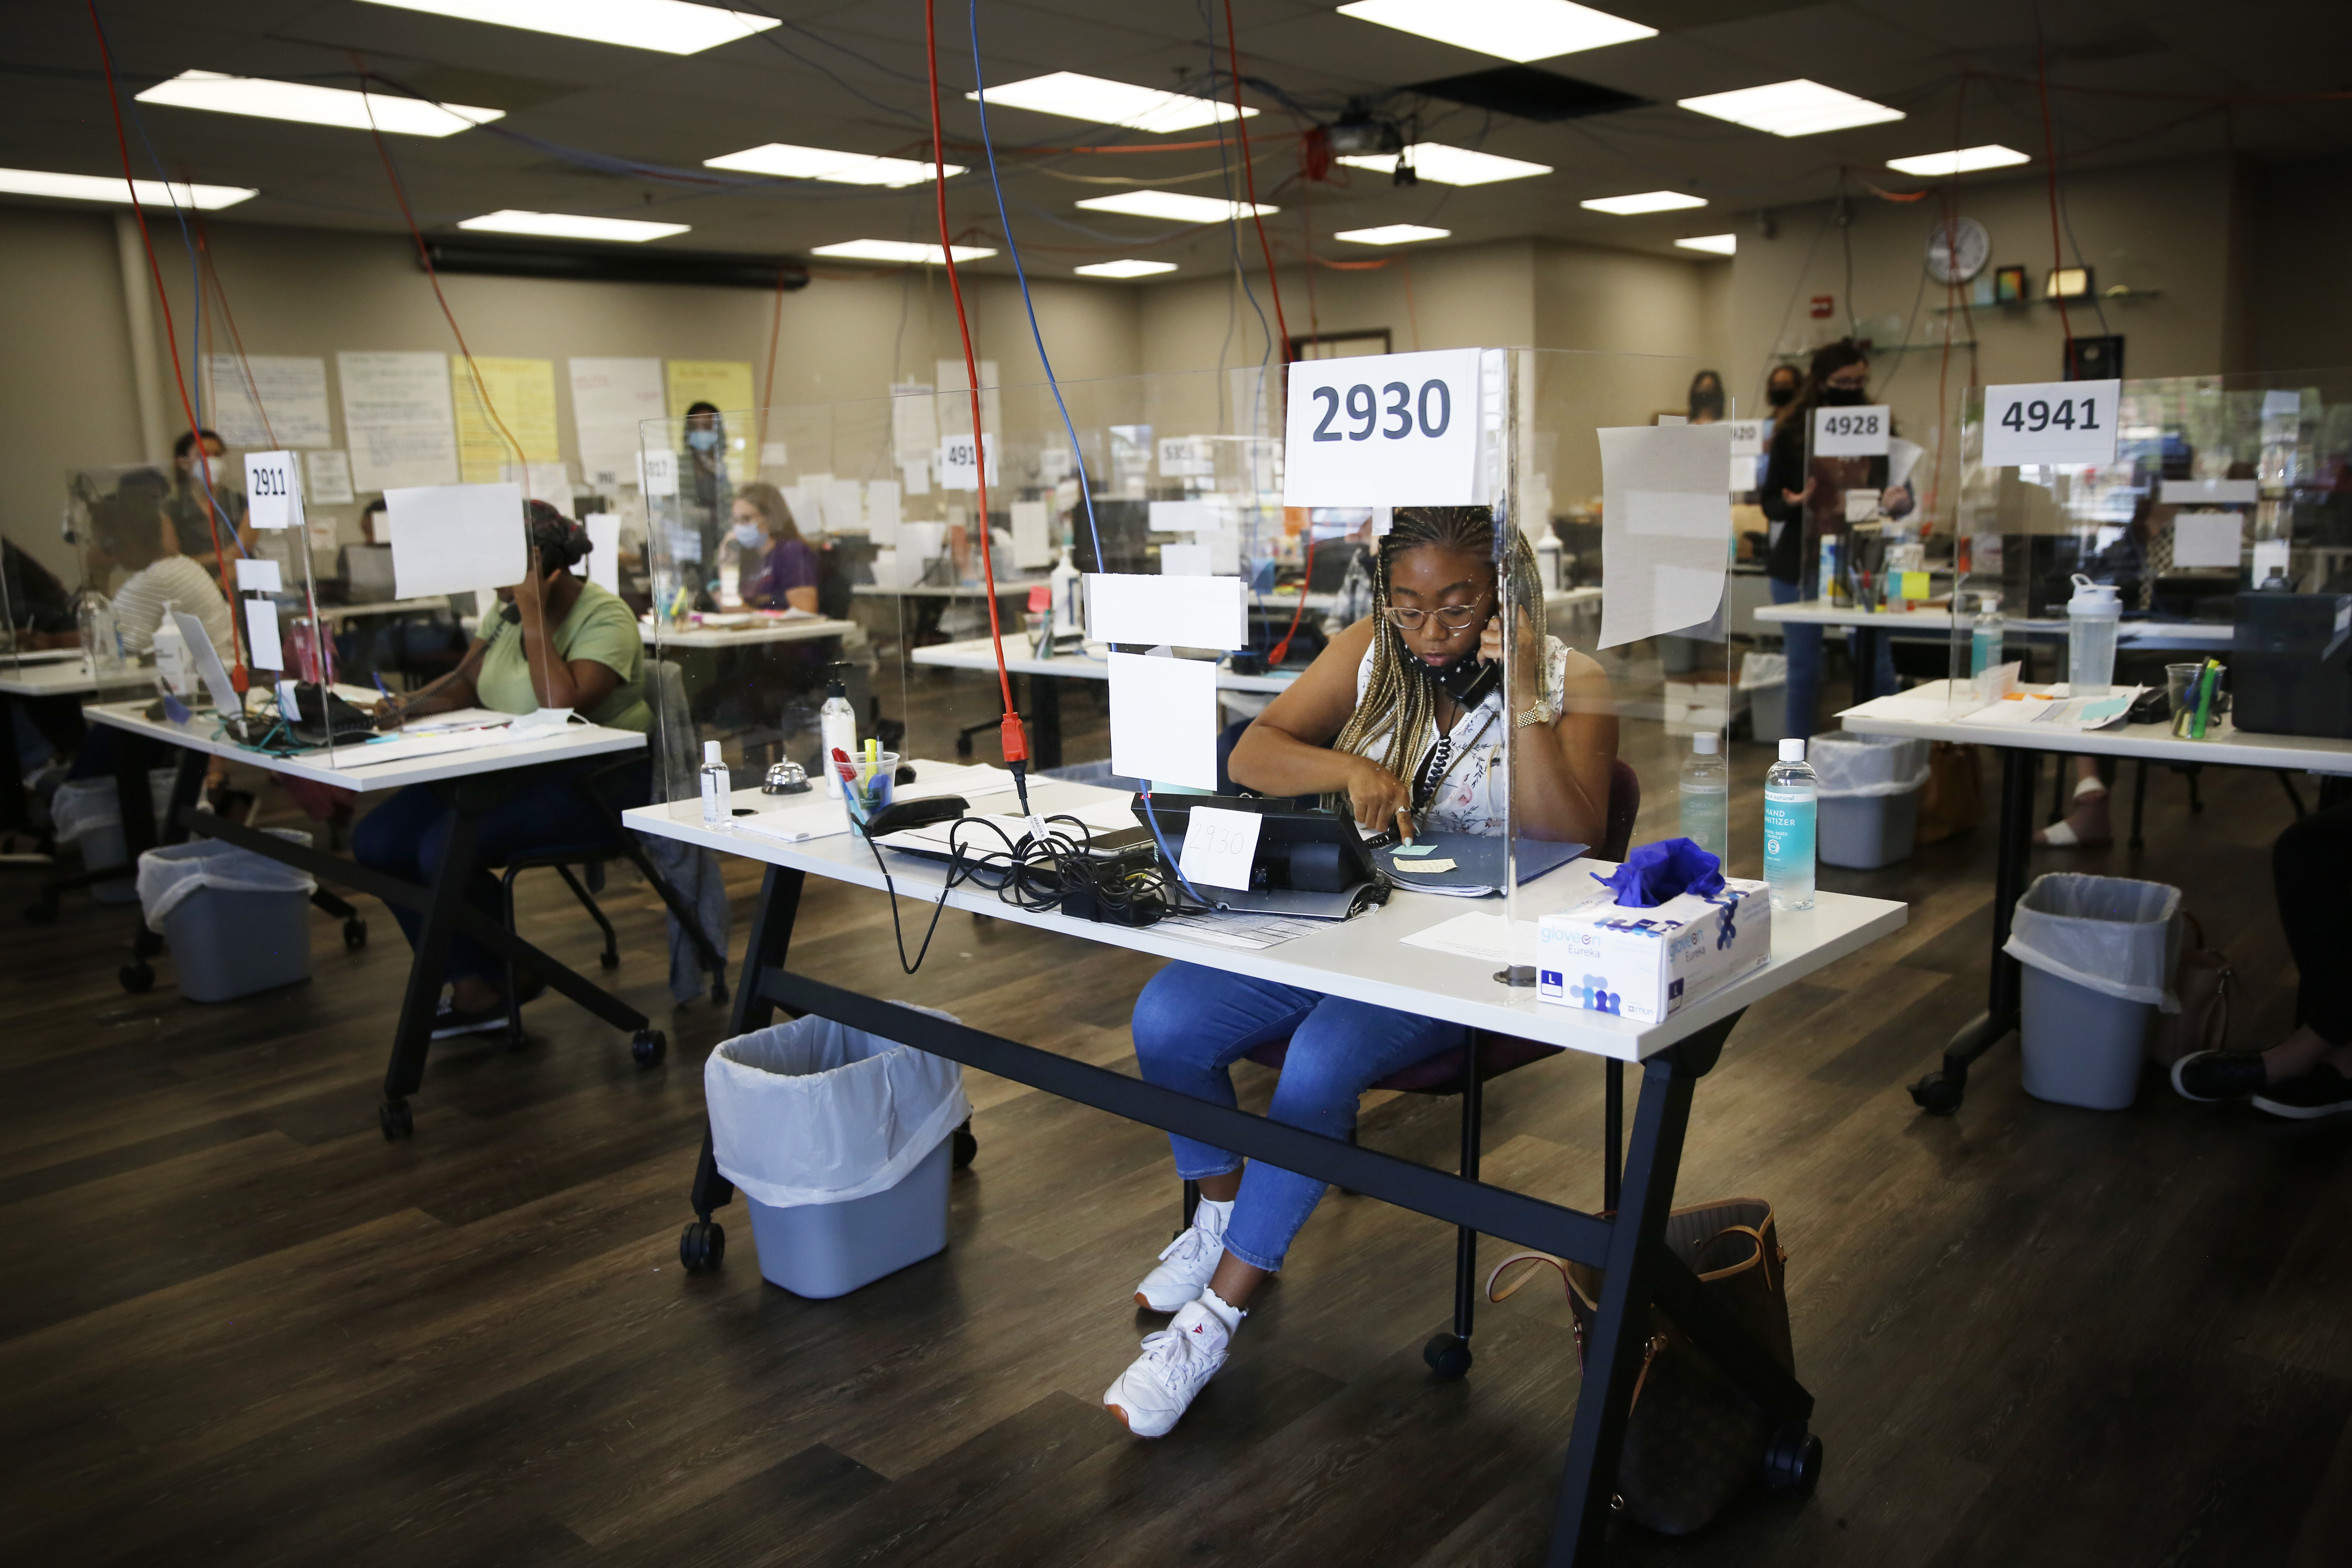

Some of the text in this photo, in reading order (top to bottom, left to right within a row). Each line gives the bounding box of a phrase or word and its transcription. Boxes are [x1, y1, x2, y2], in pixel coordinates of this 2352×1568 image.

[1313, 379, 1450, 442] 2930
[2001, 398, 2100, 432] 4941
[1825, 414, 1879, 435] 4928
[253, 468, 286, 495] 2911
[1765, 816, 1795, 826] ANITIZER
[1766, 808, 1785, 817] HAND
[1189, 823, 1244, 854] 2930
[1541, 924, 1601, 947] gloveon
[1568, 944, 1600, 958] Eureka
[1685, 946, 1705, 962] Eureka
[1548, 973, 1555, 984] L
[1674, 984, 1678, 995] L
